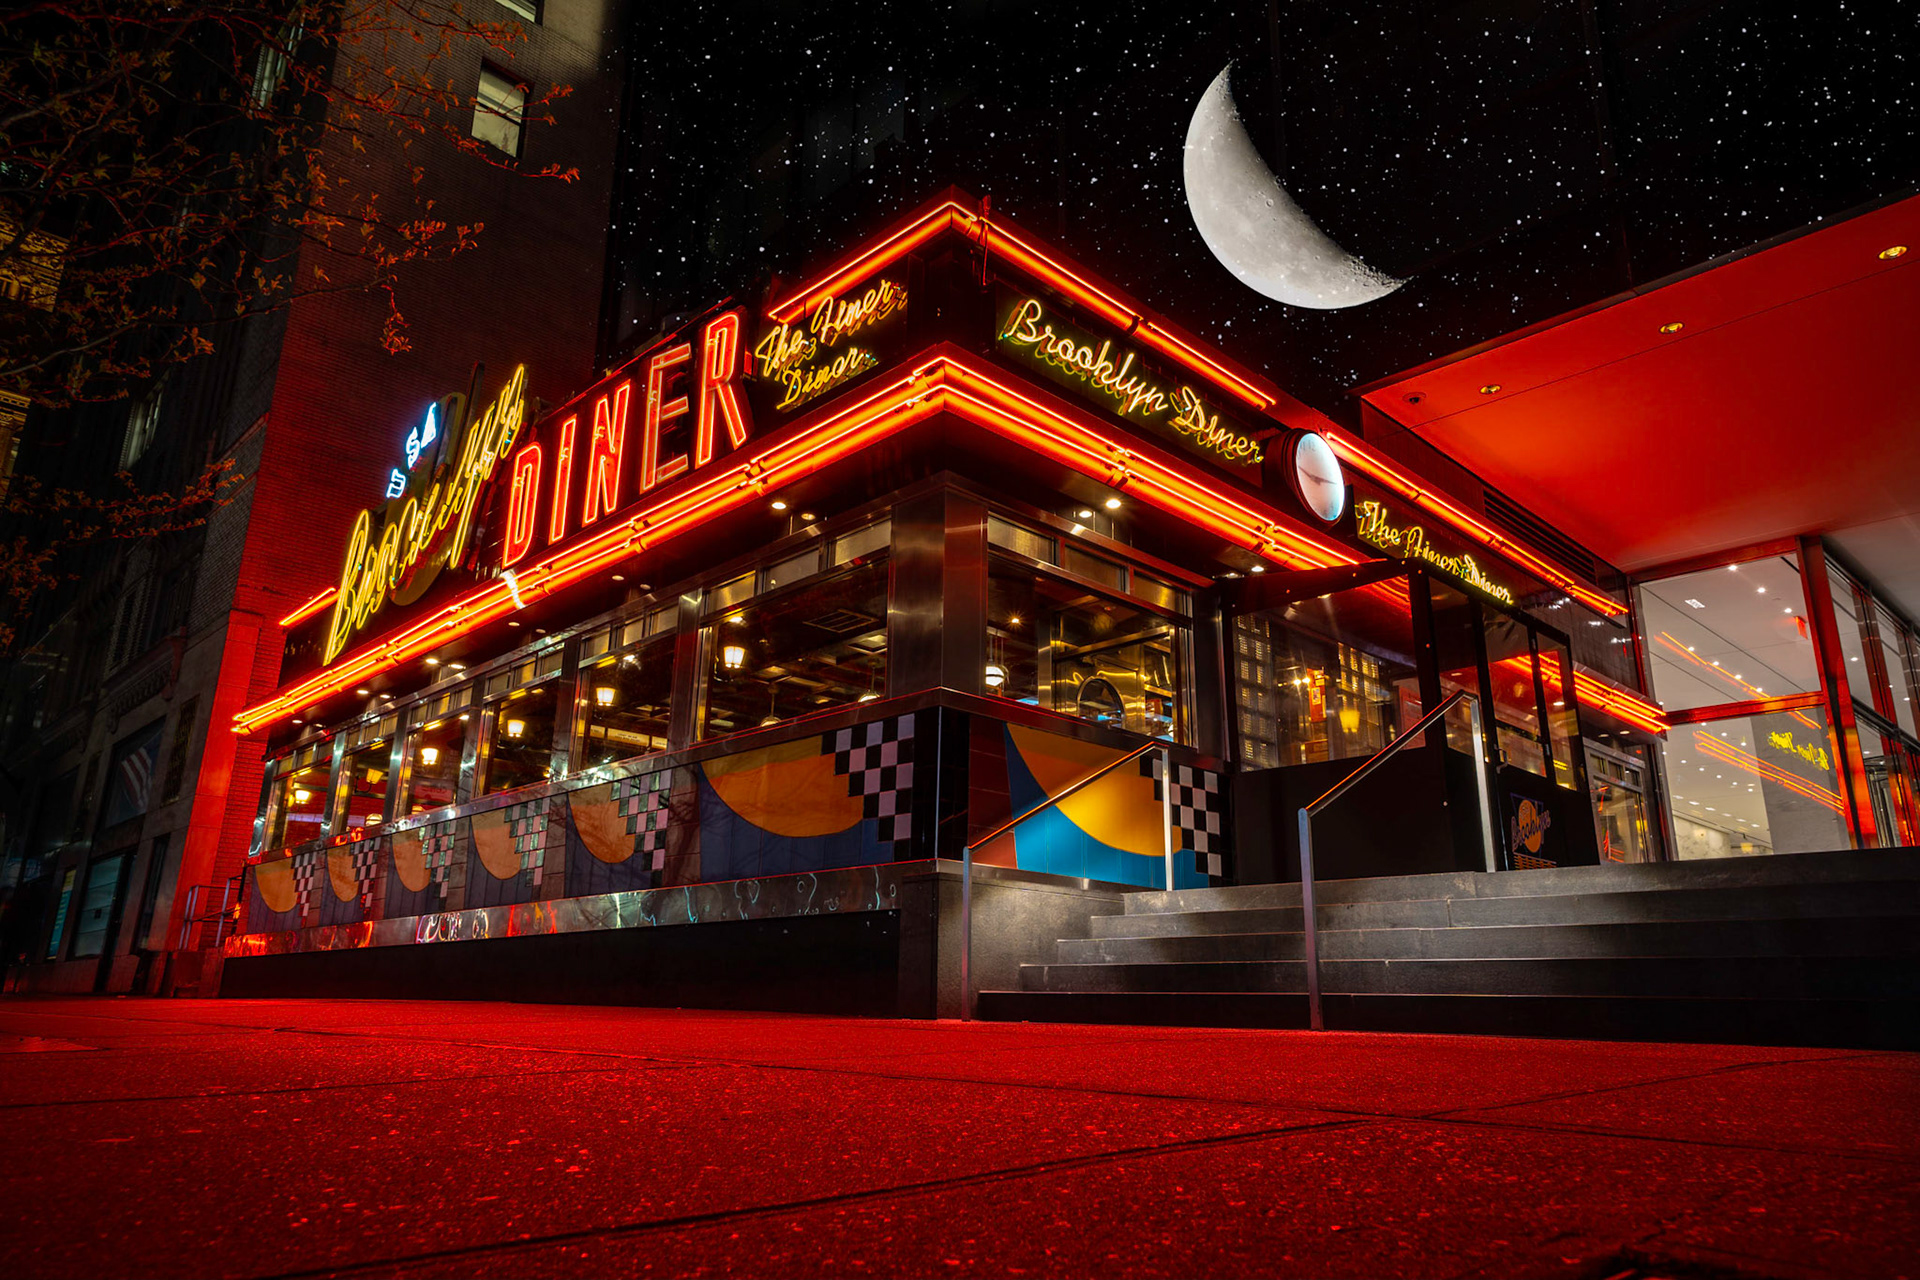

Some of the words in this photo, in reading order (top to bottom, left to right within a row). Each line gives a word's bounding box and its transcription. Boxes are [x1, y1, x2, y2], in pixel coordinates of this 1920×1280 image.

[755, 322, 810, 377] The
[810, 279, 895, 343] Finer
[776, 347, 871, 411] Diner
[1001, 299, 1169, 413] Brooklyn
[1173, 386, 1264, 463] Diner
[502, 306, 751, 569] DINER
[1363, 500, 1401, 546] The
[1406, 526, 1459, 575] Finer
[1463, 554, 1515, 605] Diner
